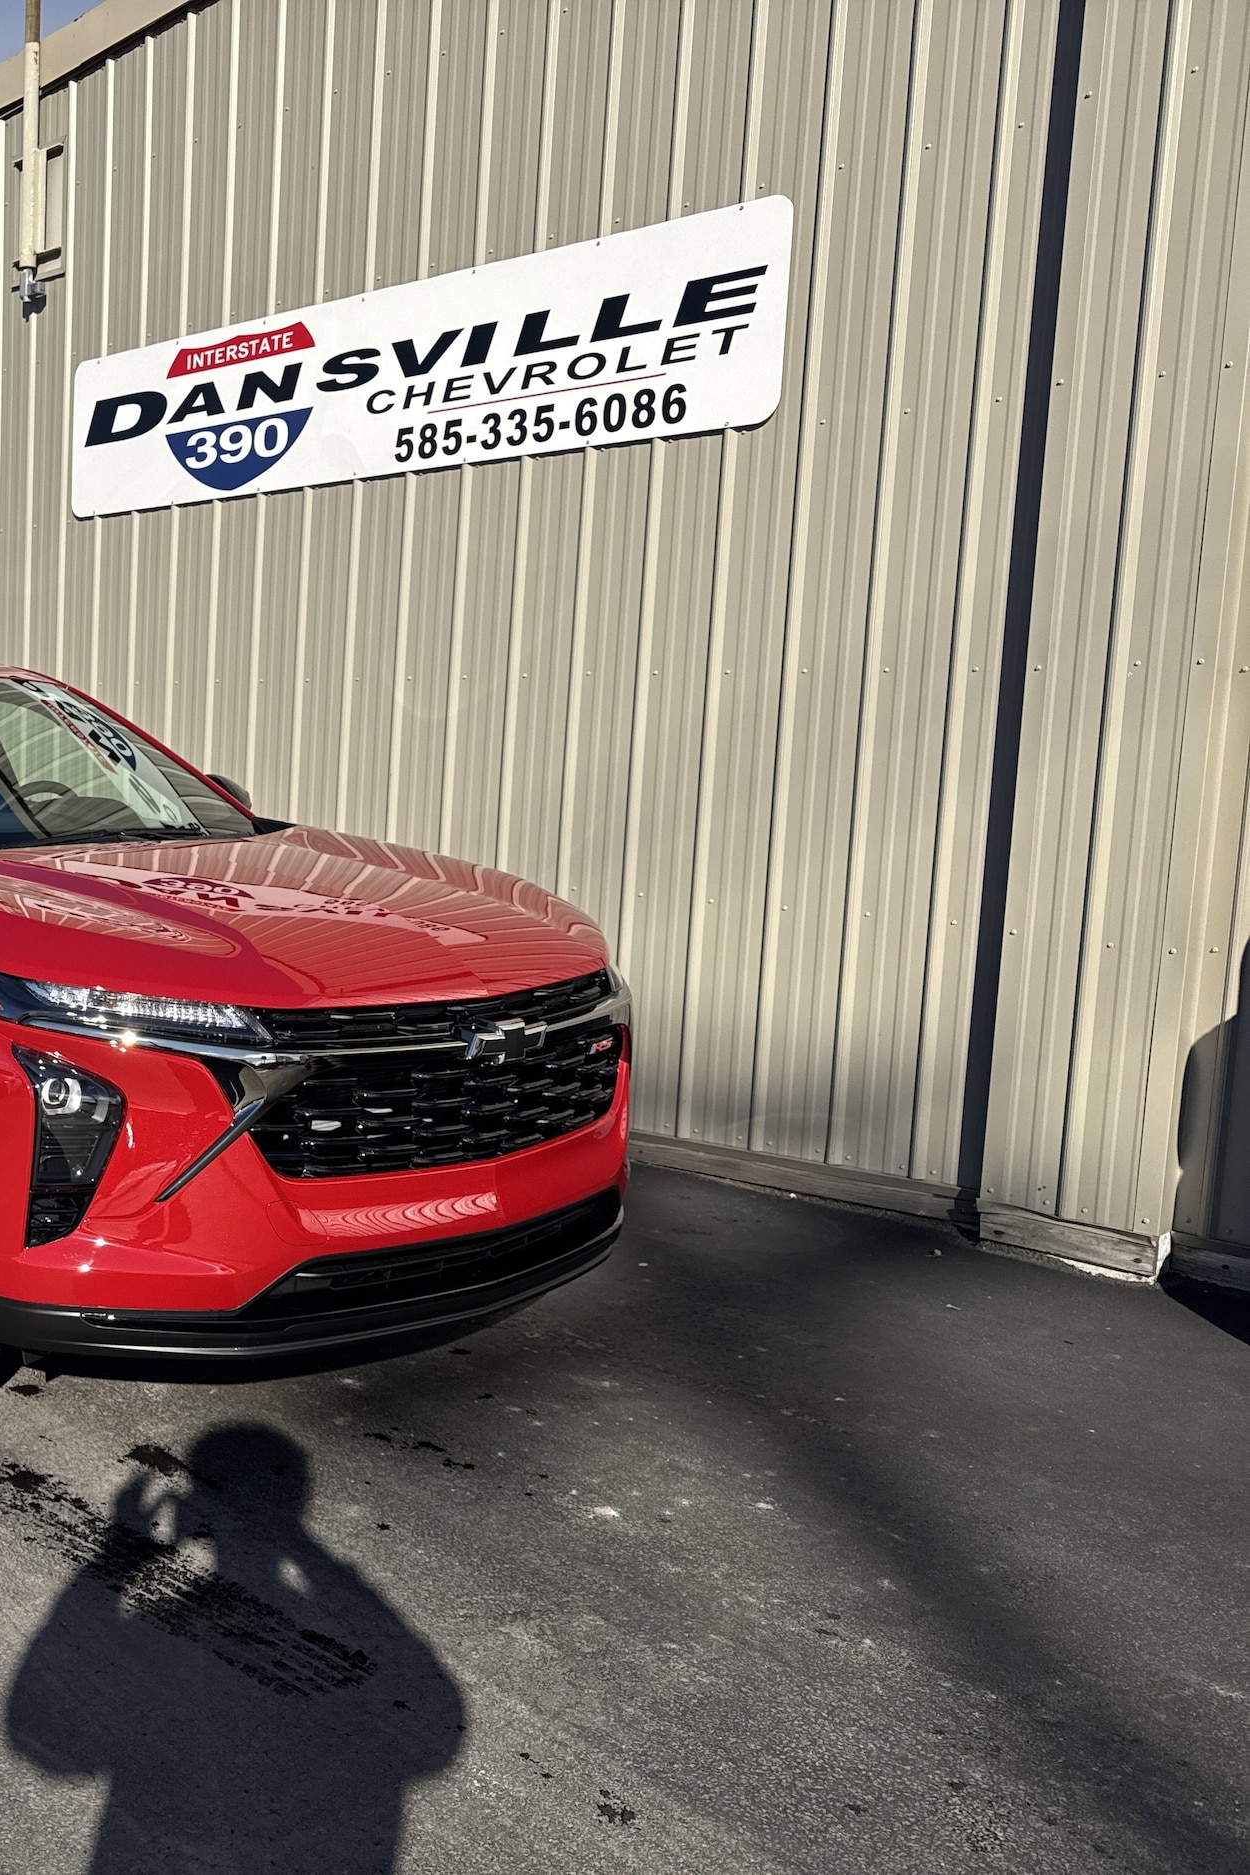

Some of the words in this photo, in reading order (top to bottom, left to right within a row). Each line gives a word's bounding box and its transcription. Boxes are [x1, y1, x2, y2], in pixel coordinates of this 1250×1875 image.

[185, 331, 294, 371] INTERSTATE
[366, 323, 750, 415] CHEVROLET
[185, 417, 289, 469] 390
[394, 383, 687, 463] 585-335-6086
